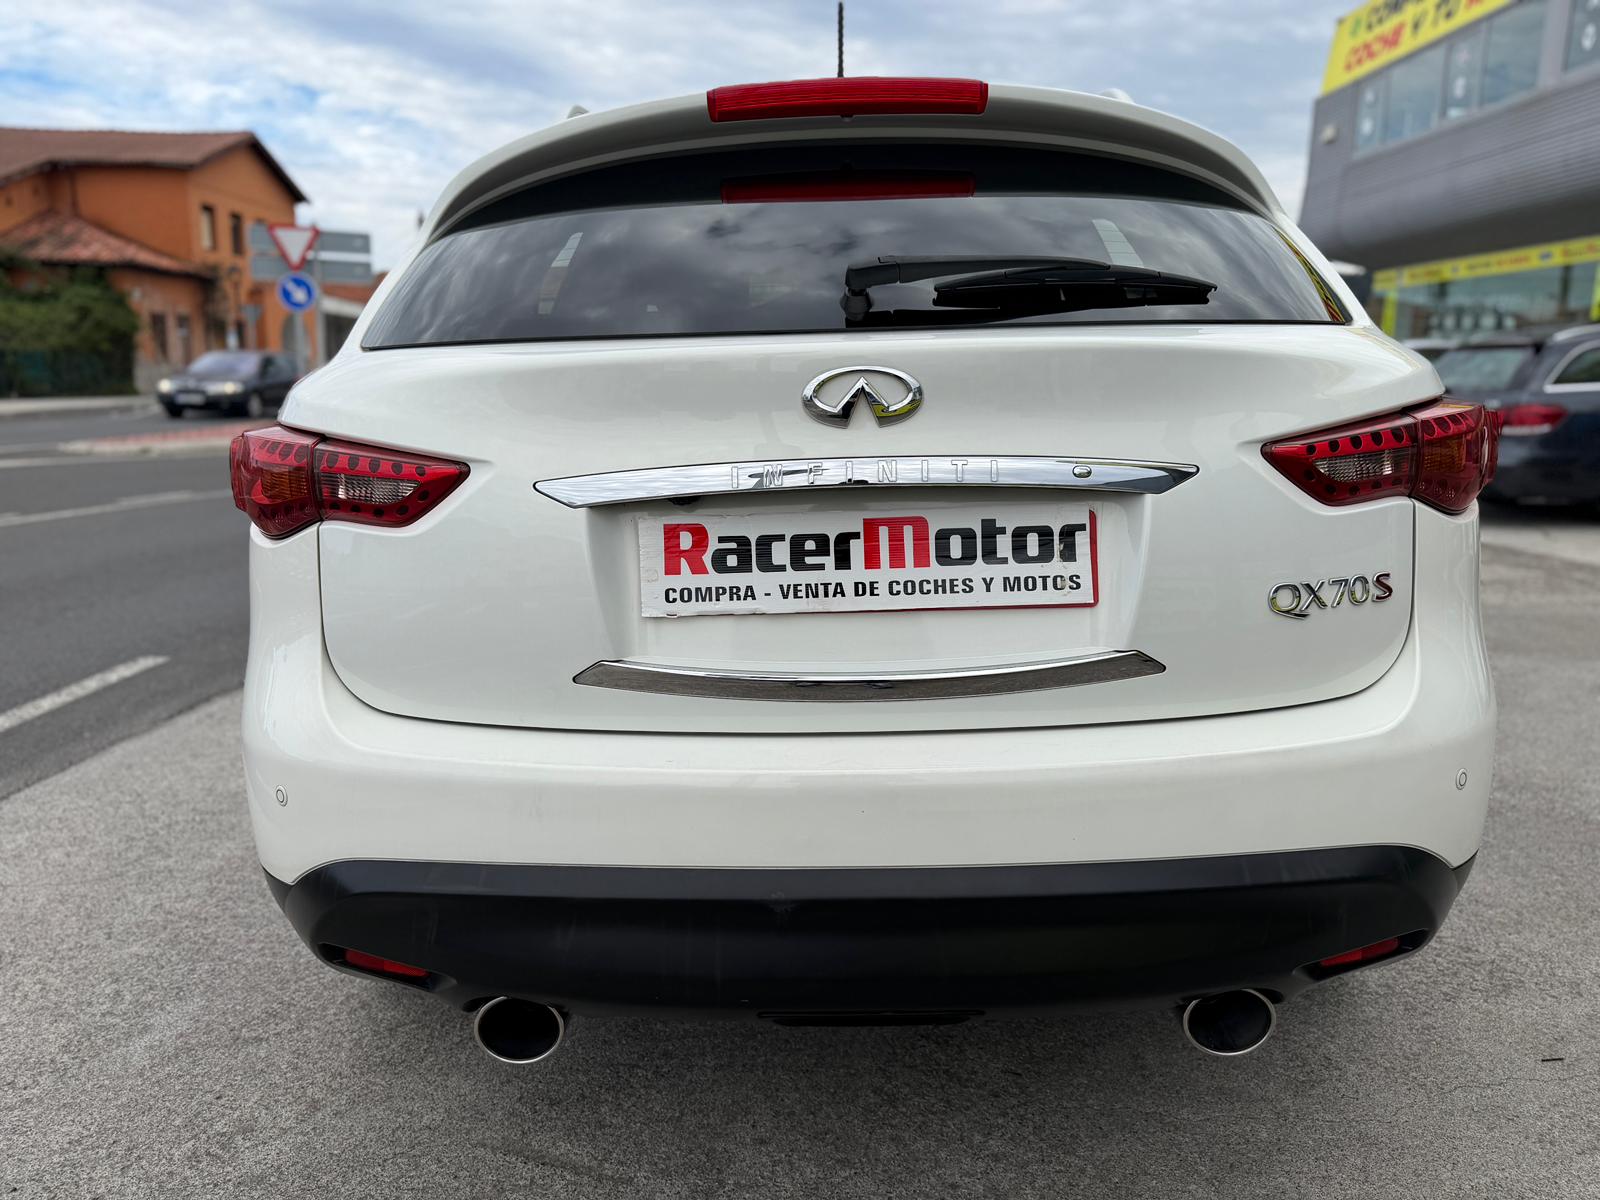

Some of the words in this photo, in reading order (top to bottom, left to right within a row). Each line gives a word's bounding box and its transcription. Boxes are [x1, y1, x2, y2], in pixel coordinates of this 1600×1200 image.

[730, 459, 998, 490] INFINITI
[663, 515, 1087, 576] RacerMotor
[664, 584, 757, 604] COMPRA
[778, 581, 847, 600] VENTA
[854, 580, 880, 597] DE
[888, 577, 974, 596] COCHES
[981, 576, 995, 593] Y
[1002, 574, 1082, 593] MOTOS
[1267, 571, 1394, 620] QX70S
